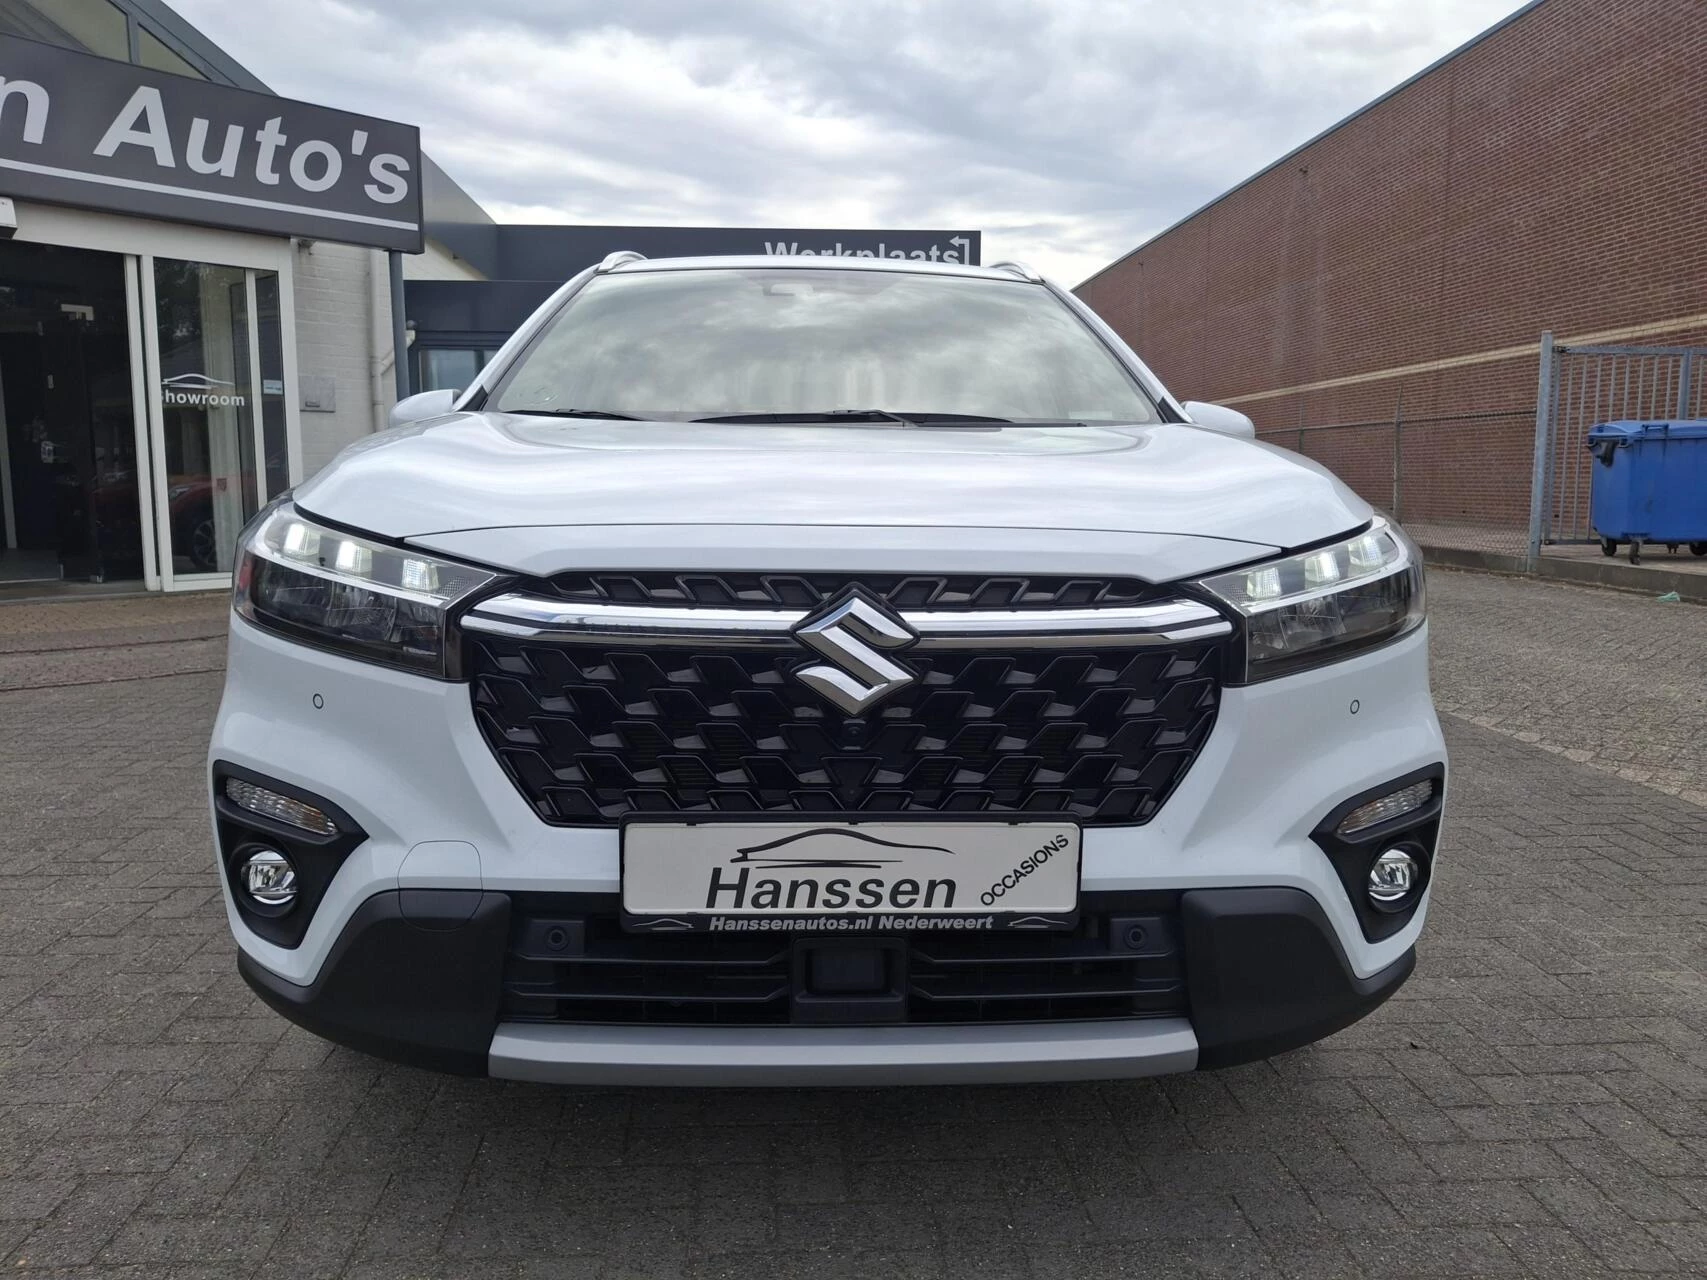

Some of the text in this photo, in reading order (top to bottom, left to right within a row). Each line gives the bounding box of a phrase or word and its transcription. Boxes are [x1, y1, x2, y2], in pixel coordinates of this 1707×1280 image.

[92, 85, 411, 204] Auto's
[764, 241, 960, 265] Wklaats
[161, 389, 245, 406] howroom
[980, 834, 1070, 907] OCCASIONS
[705, 867, 957, 909] Hanssen
[709, 915, 994, 931] Hanssenautos.nl Nederweert
